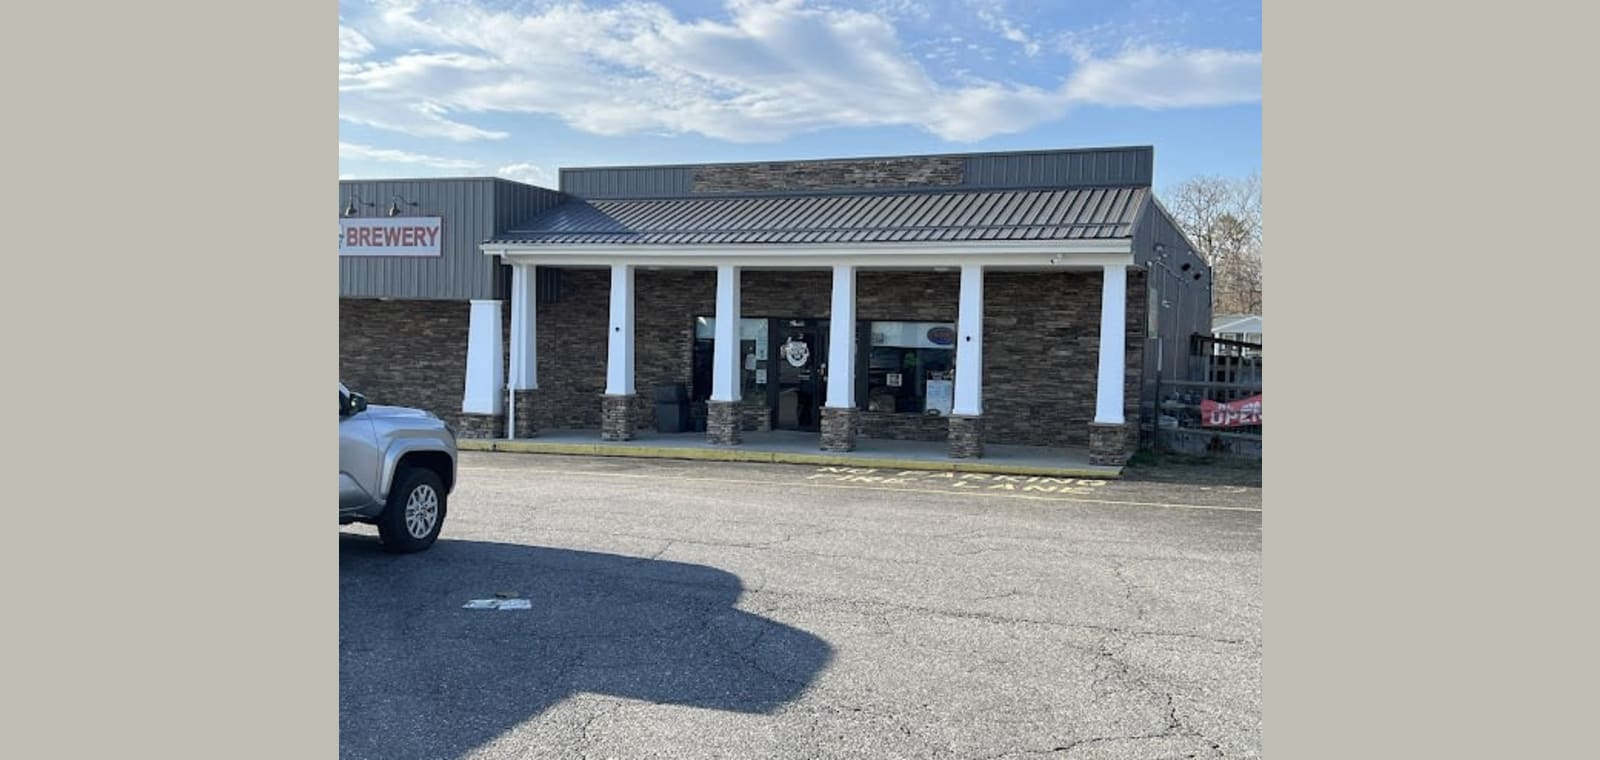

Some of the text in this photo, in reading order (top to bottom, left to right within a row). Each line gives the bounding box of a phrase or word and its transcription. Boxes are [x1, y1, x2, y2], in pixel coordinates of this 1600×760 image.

[346, 226, 440, 247] BREWERY
[806, 473, 1094, 495] FIRE LANE
[816, 466, 1109, 486] NO PARKING
